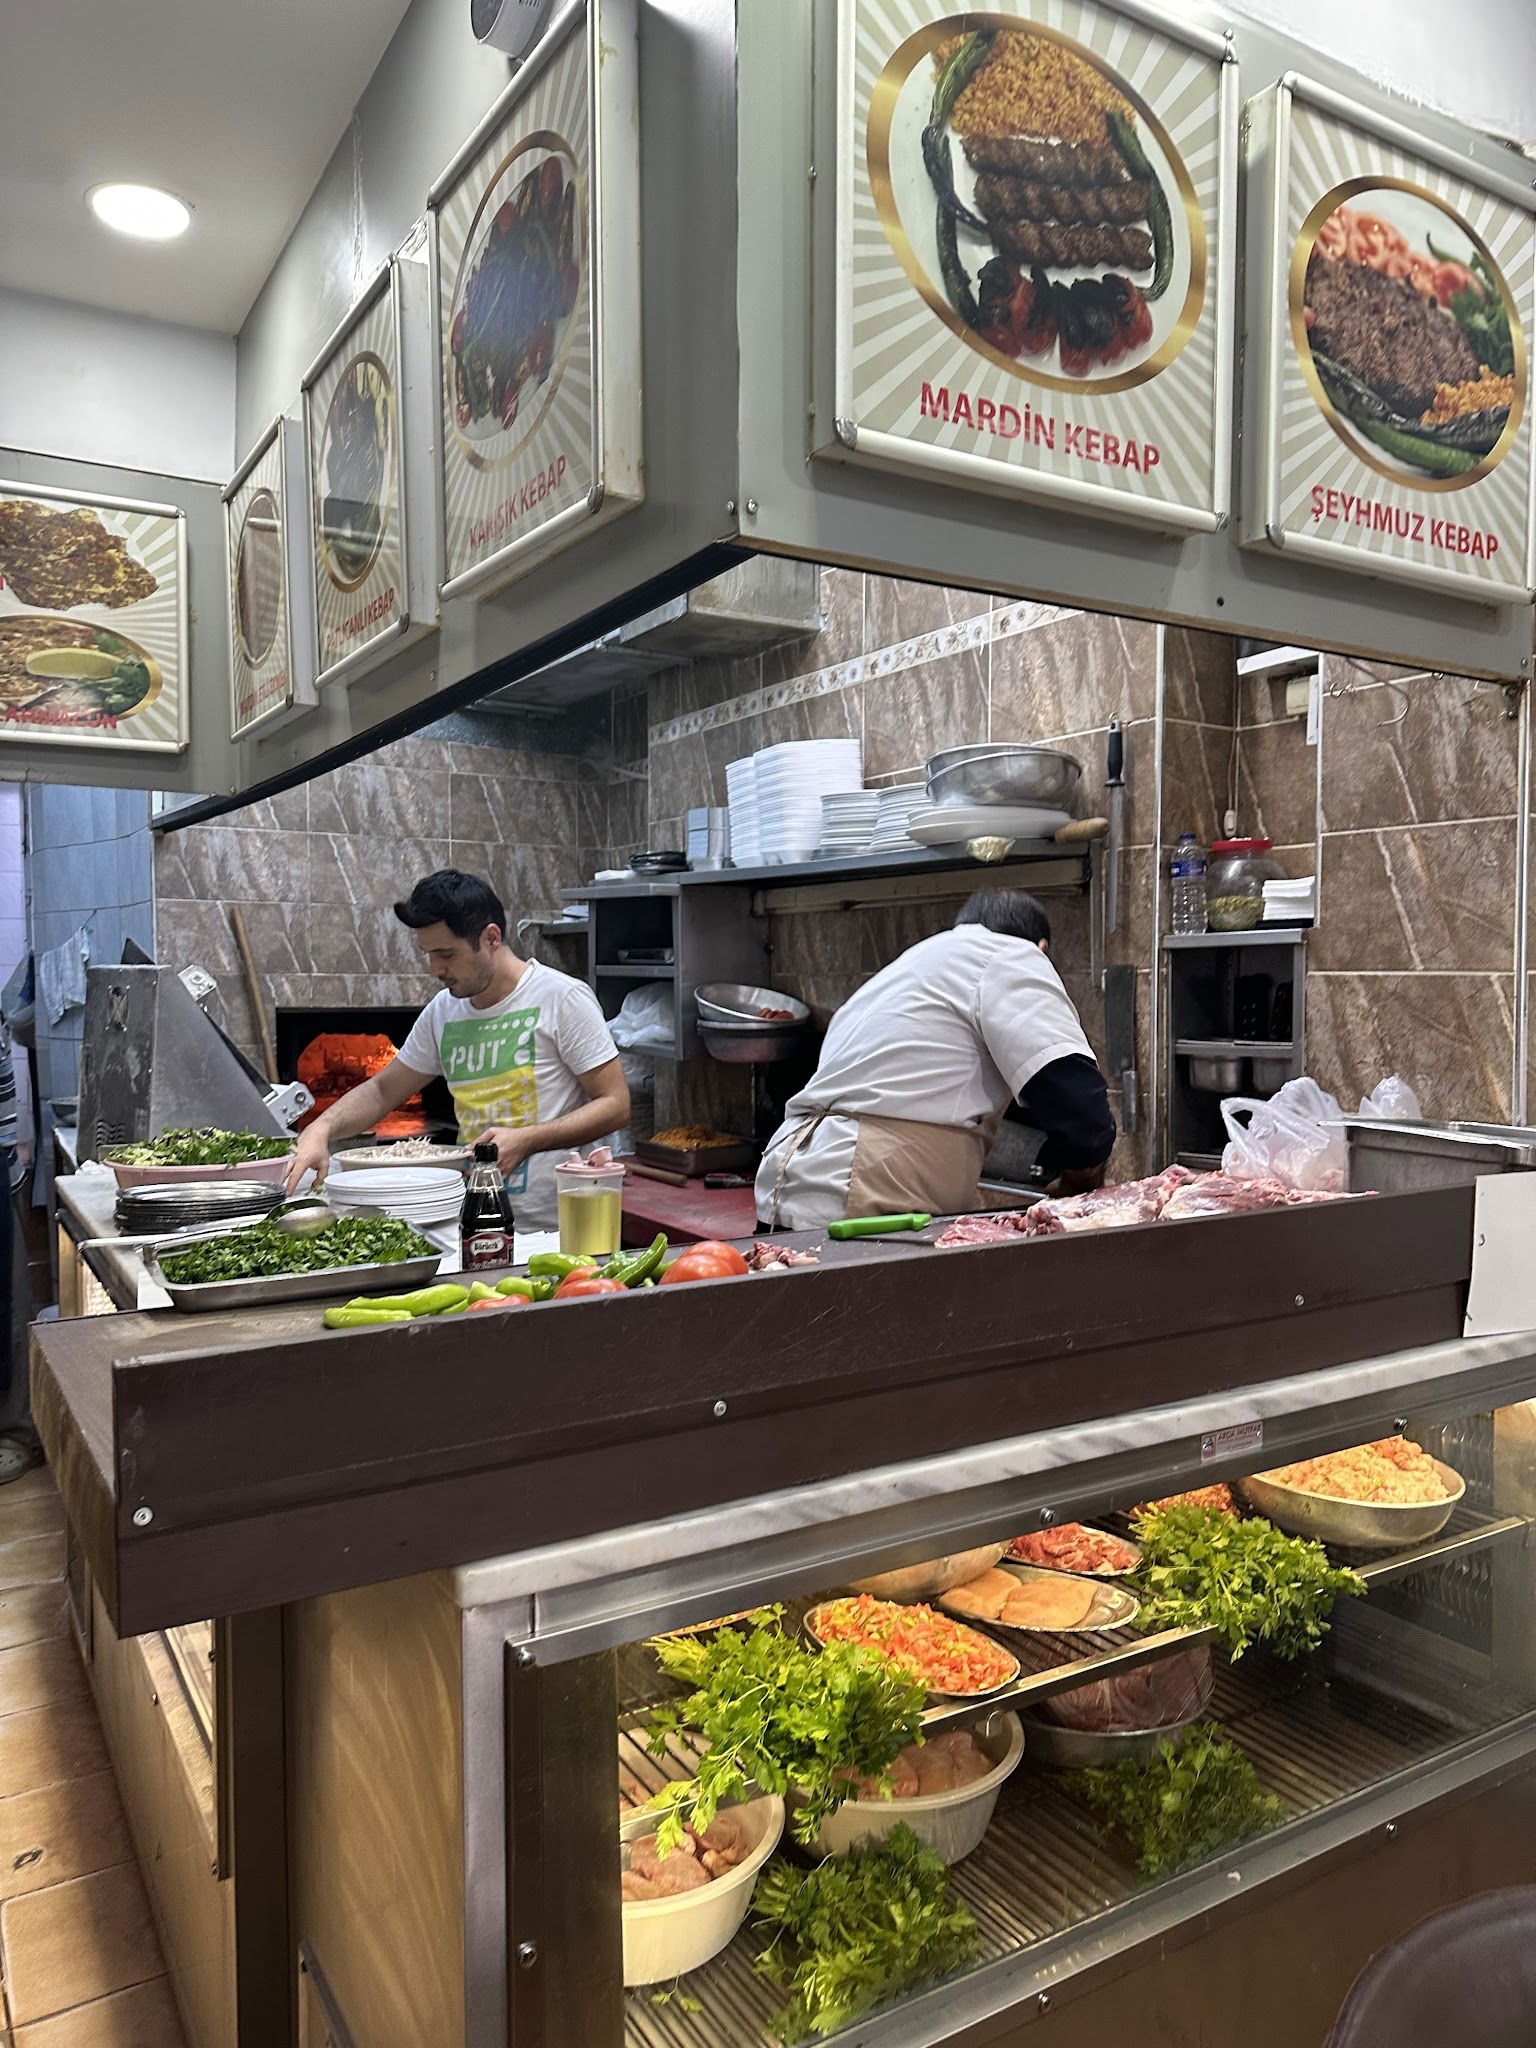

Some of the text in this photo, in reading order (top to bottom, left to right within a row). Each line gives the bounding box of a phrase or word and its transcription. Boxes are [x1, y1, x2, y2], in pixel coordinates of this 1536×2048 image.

[919, 381, 1161, 475] MARDİN KEBAP
[520, 454, 567, 515] KEBAP
[1310, 484, 1499, 560] ŞEYHMUZ KEBAP
[368, 587, 395, 626] KEBAP
[449, 1038, 507, 1074] PUT
